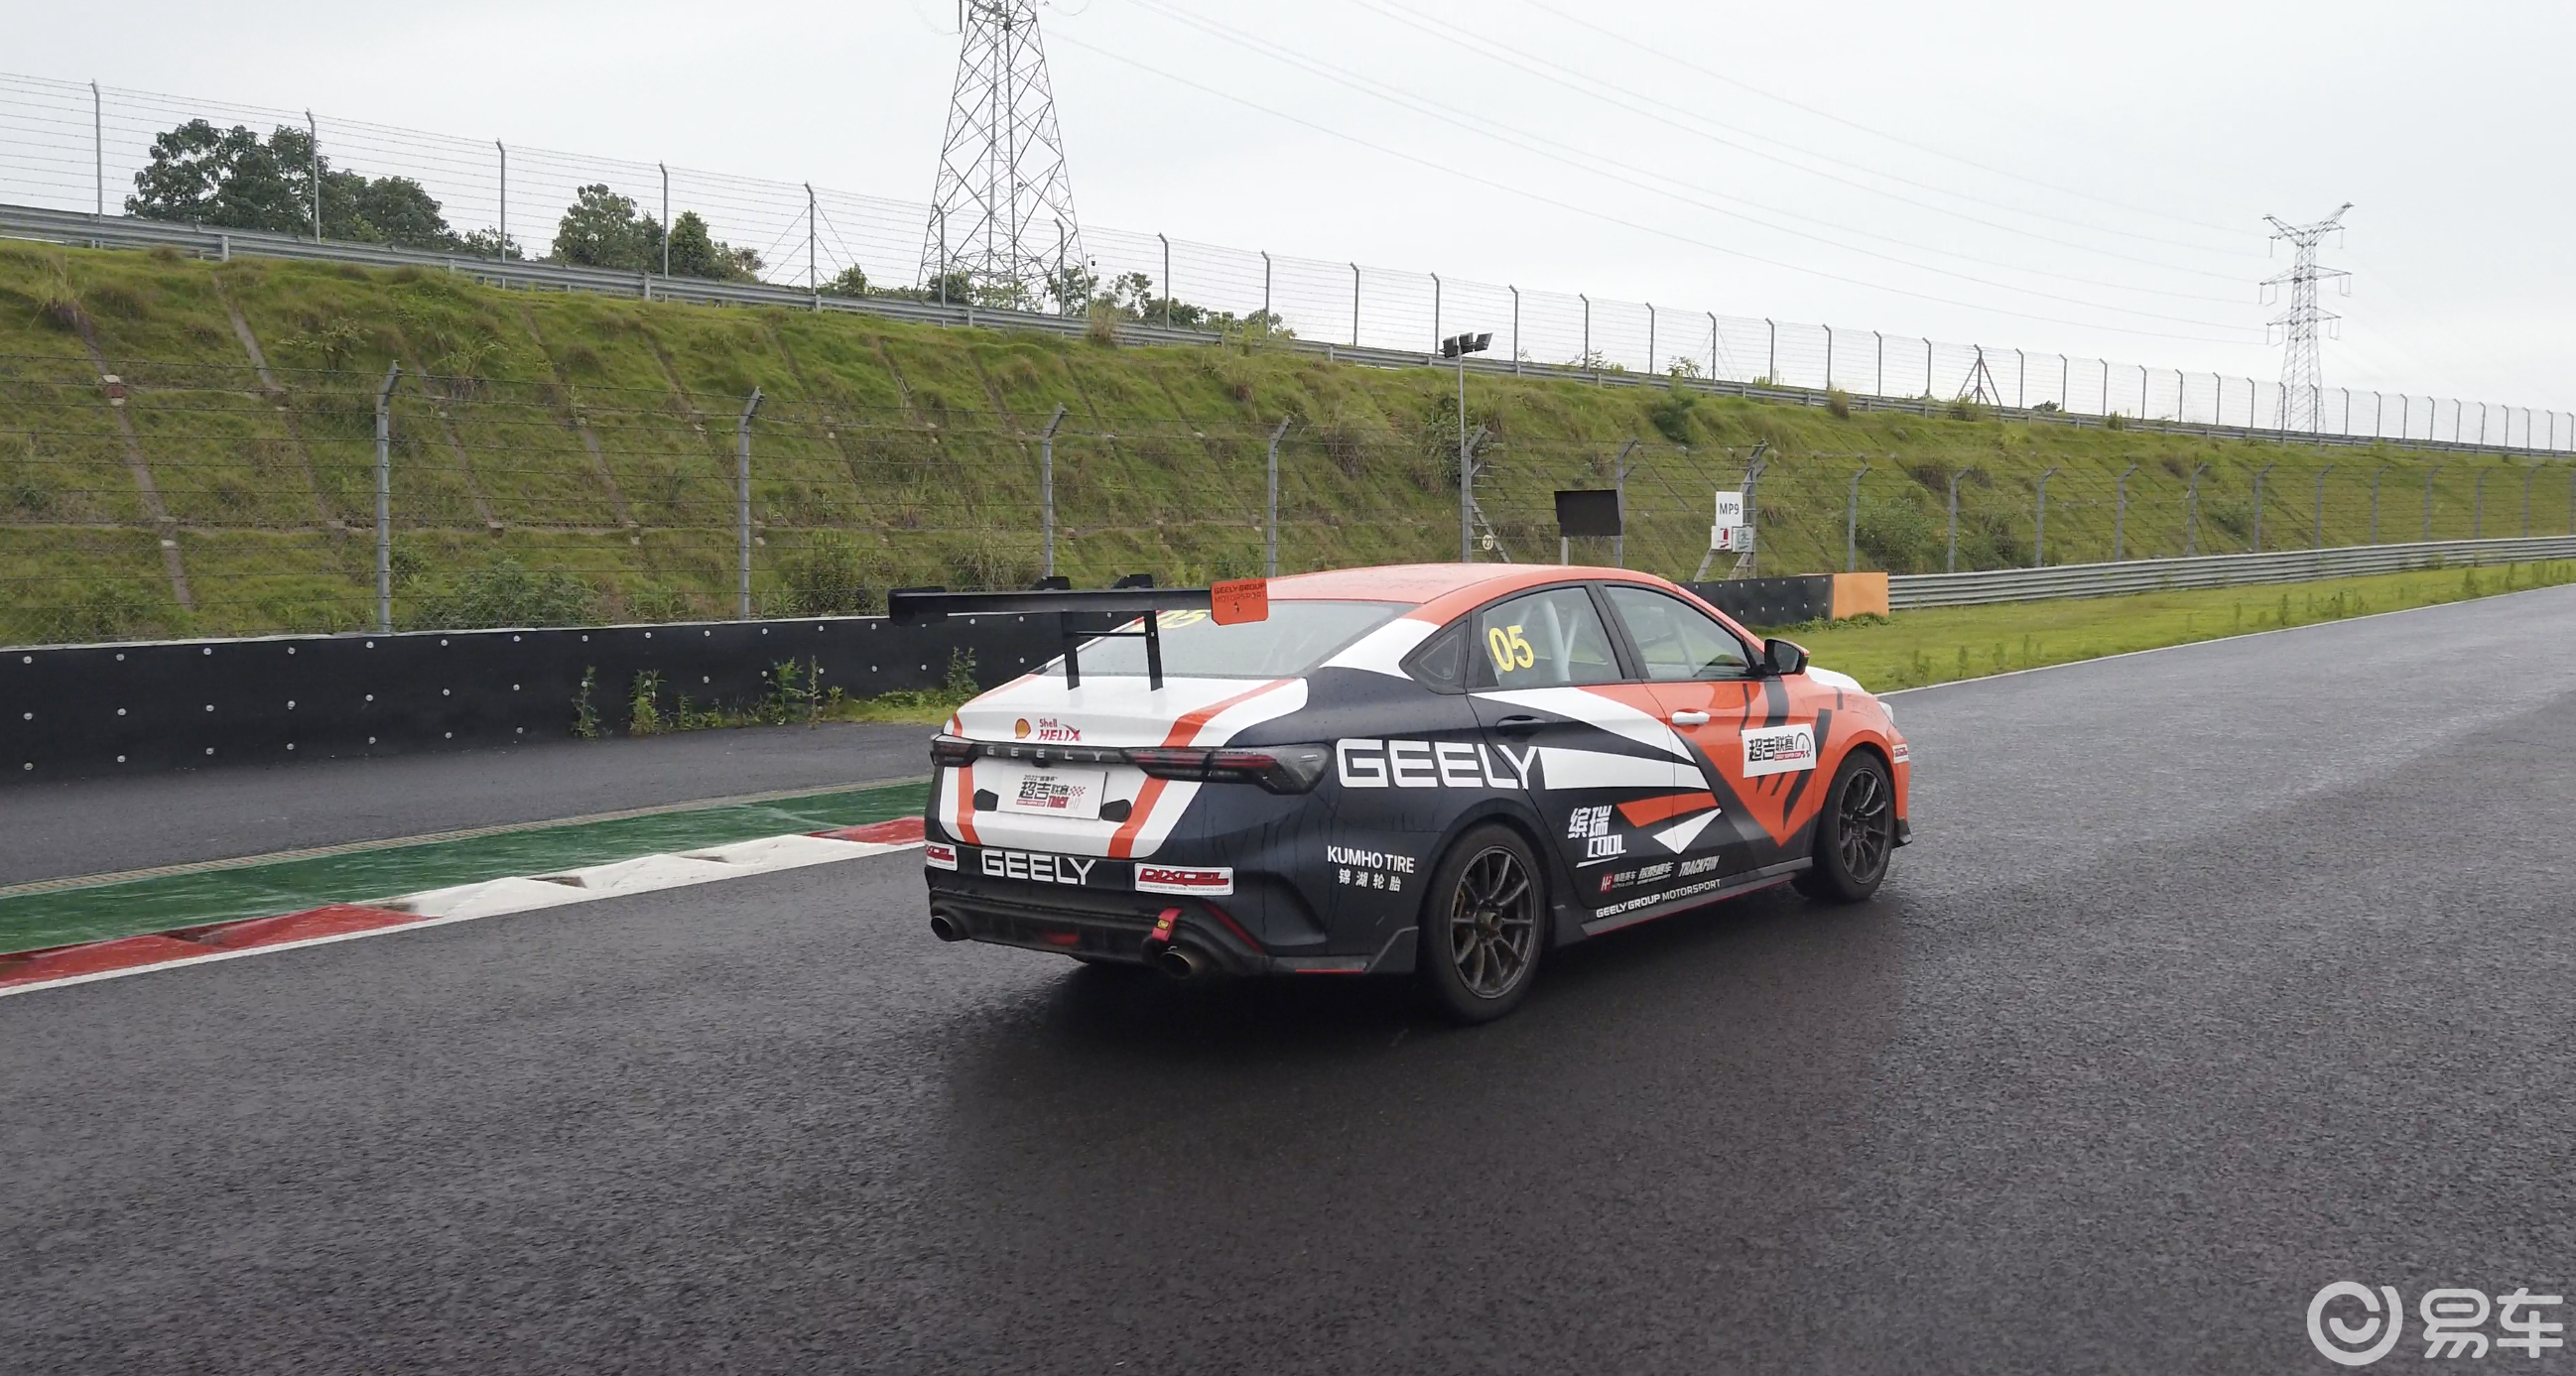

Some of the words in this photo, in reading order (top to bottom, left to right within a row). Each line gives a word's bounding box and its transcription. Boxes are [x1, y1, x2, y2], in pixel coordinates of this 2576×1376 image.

[1719, 502, 1739, 515] MP9
[1214, 586, 1238, 595] GEELY
[1488, 624, 1534, 672] 05
[1038, 727, 1081, 742] HELIX
[1039, 717, 1058, 728] Shell
[986, 745, 1104, 762] GEELY
[1748, 734, 1794, 763] 超吉联赛
[1336, 738, 1538, 791] GEELY
[1018, 781, 1071, 801] 超吉联赛
[1568, 805, 1612, 839] 缤瑞
[1587, 834, 1627, 858] COOL
[980, 848, 1095, 885] GEELY
[1327, 845, 1383, 869] KUMHO
[1383, 853, 1415, 874] TIRE
[1678, 855, 1721, 878] TRACKFUN
[1339, 868, 1402, 893] 锦湖轮胎
[1596, 900, 1628, 919] GEELY
[1627, 894, 1661, 911] GROUP
[1662, 878, 1722, 902] MOTORSPORT
